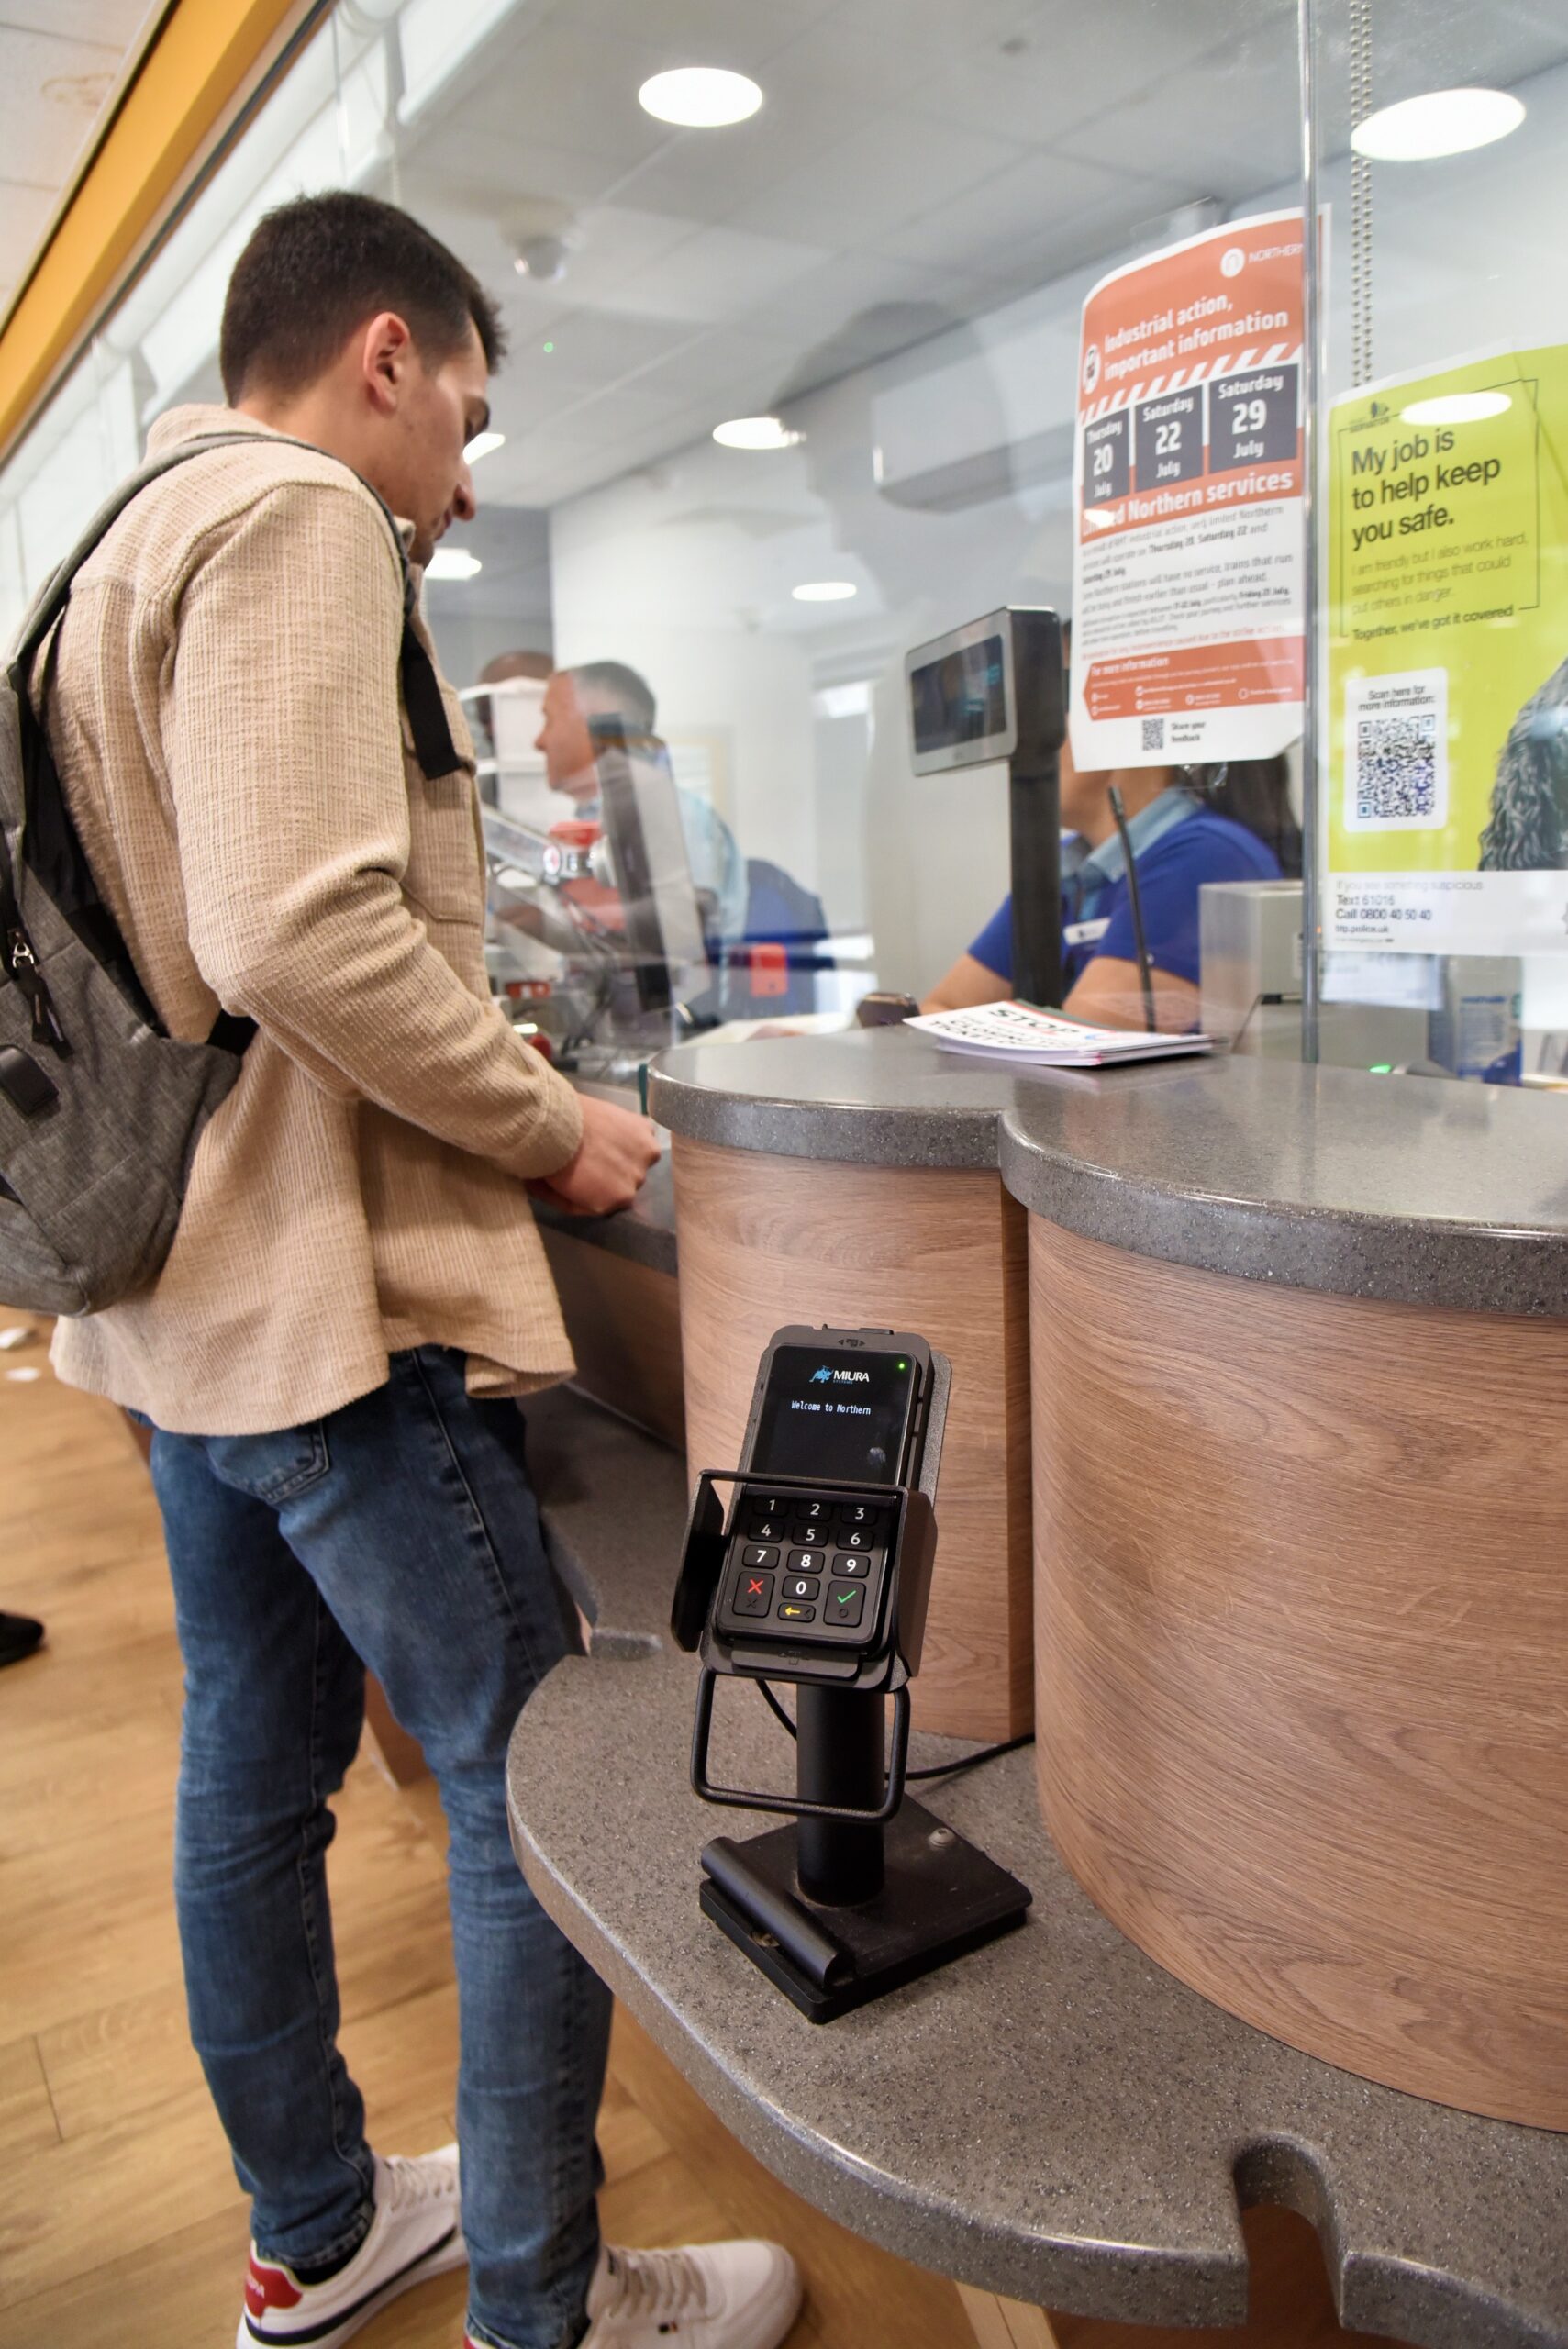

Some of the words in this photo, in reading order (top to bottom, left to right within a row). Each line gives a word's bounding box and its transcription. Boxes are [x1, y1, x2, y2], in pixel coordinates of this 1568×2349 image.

[1105, 308, 1173, 354] Industrial
[1176, 295, 1233, 326] action,
[1105, 340, 1175, 382] important
[1178, 311, 1289, 355] information
[1218, 375, 1284, 399] Saturday
[1142, 396, 1194, 422] Saturday
[1232, 399, 1267, 435] 29
[1086, 420, 1123, 445] Thursday
[1155, 421, 1182, 456] 22
[1233, 440, 1264, 459] July
[1352, 446, 1387, 476] My
[1392, 433, 1429, 471] job
[1435, 428, 1454, 453] is
[1093, 444, 1114, 477] 20
[1156, 460, 1181, 478] July
[1094, 481, 1113, 499] July
[1351, 488, 1374, 510] to
[1381, 472, 1429, 505] help
[1436, 459, 1501, 491] keep
[1129, 489, 1204, 521] Northern
[1207, 471, 1294, 503] services
[1198, 529, 1235, 543] Saturday
[1352, 520, 1393, 551] you
[1399, 504, 1454, 535] safe.
[1464, 538, 1493, 552] work
[1476, 554, 1511, 572] could
[1352, 625, 1399, 641] Together,
[1432, 614, 1451, 630] got
[1453, 612, 1461, 625] it
[1368, 689, 1389, 700] Scan
[1392, 687, 1411, 697] here
[1413, 685, 1426, 695] for
[1358, 702, 1381, 712] more
[1430, 880, 1484, 893] suspicious
[1337, 894, 1361, 907] Text
[1336, 907, 1357, 920] Call
[1360, 908, 1388, 920] 0800
[1390, 909, 1403, 920] 40
[1405, 909, 1417, 921] 50
[1418, 909, 1432, 921] 40
[833, 1370, 870, 1383] MIURA
[791, 1400, 821, 1412] Welcome
[825, 1403, 834, 1412] to
[837, 1404, 872, 1416] Northern
[768, 1499, 776, 1512] 1
[810, 1503, 820, 1517] 2
[855, 1508, 865, 1520] 3
[761, 1525, 772, 1537] 4
[806, 1529, 816, 1542] 5
[851, 1532, 862, 1546] 6
[756, 1549, 767, 1563] 7
[800, 1554, 812, 1568] 8
[846, 1558, 857, 1573] 9
[795, 1581, 807, 1595] 0
